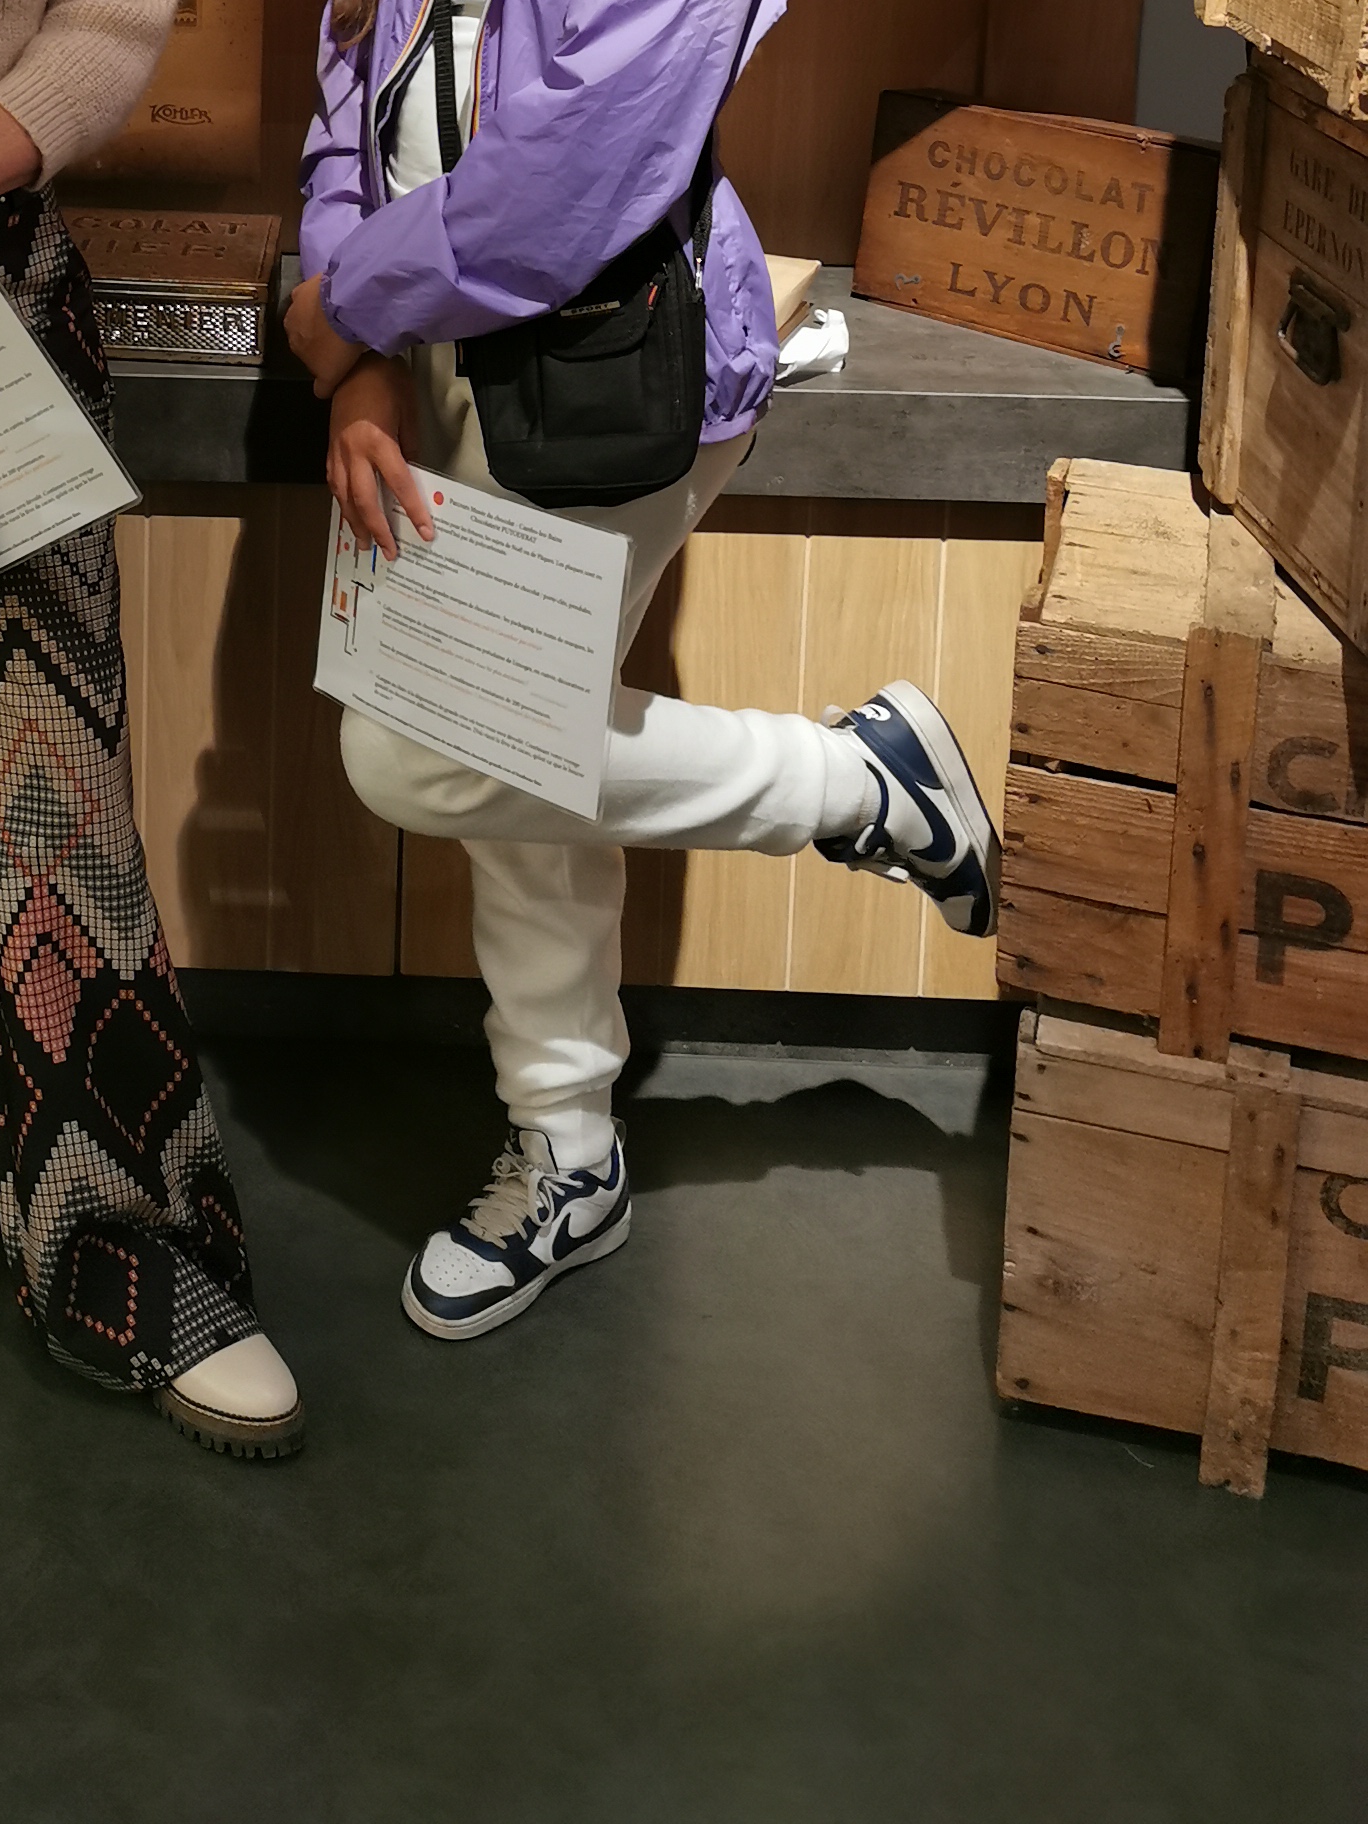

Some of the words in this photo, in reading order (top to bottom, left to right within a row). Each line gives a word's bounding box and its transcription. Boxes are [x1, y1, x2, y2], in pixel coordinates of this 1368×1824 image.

[149, 104, 213, 125] KOHLER
[928, 139, 1155, 214] CHOCOLAT
[893, 180, 1170, 280] RÉVILLON
[947, 261, 1098, 327] LYON
[1255, 869, 1354, 985] P
